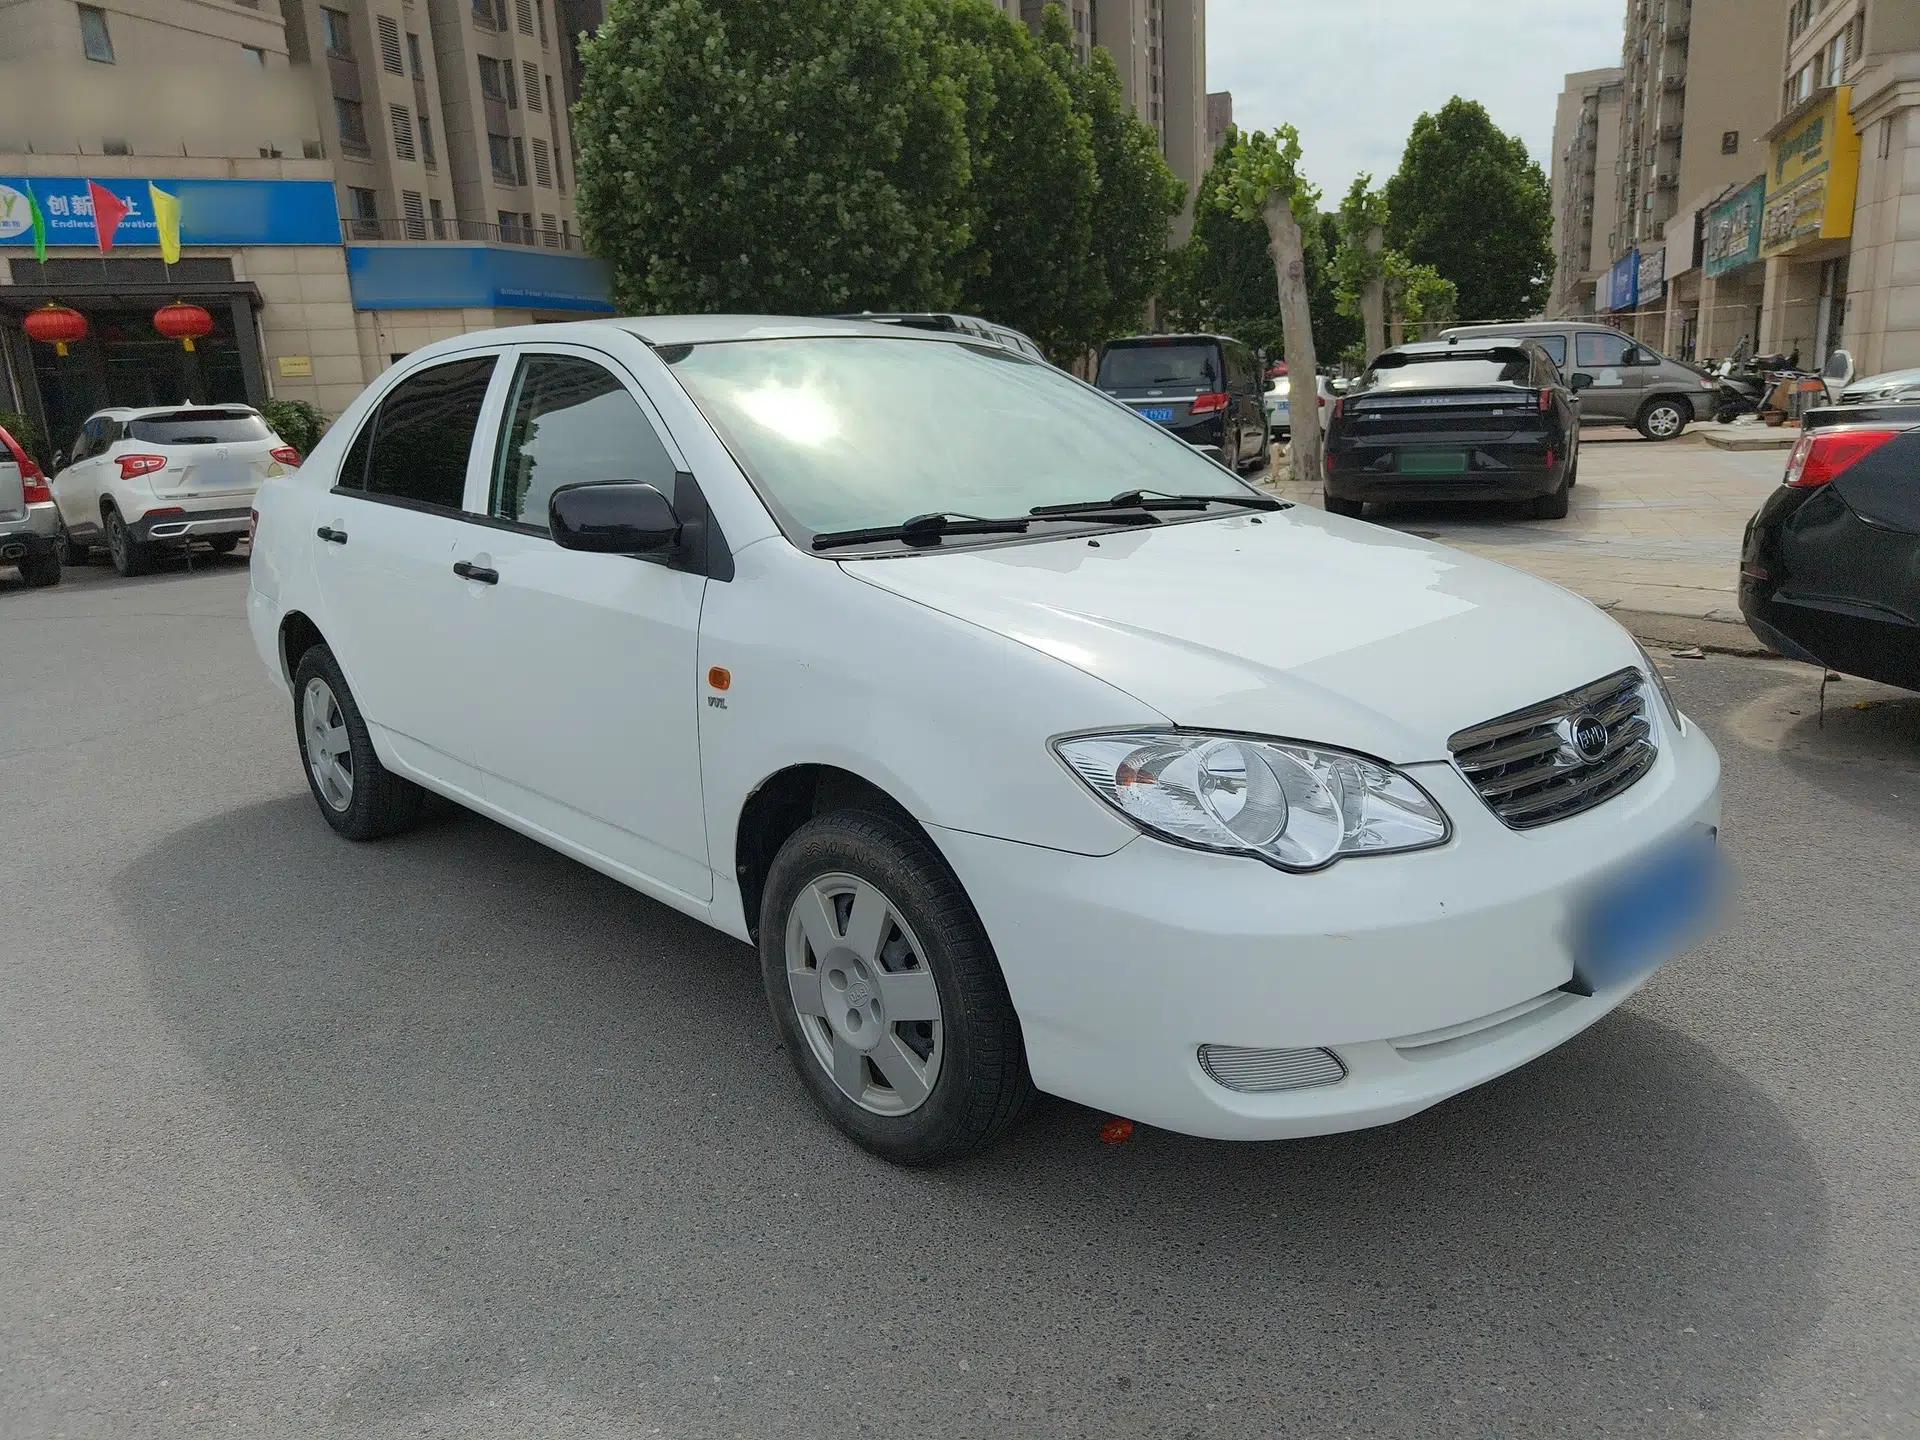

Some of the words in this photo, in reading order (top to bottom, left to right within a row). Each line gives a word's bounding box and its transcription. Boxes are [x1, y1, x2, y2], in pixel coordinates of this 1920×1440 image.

[47, 195, 141, 216] 创新止
[51, 219, 95, 228] Endless
[1577, 724, 1606, 750] BYD
